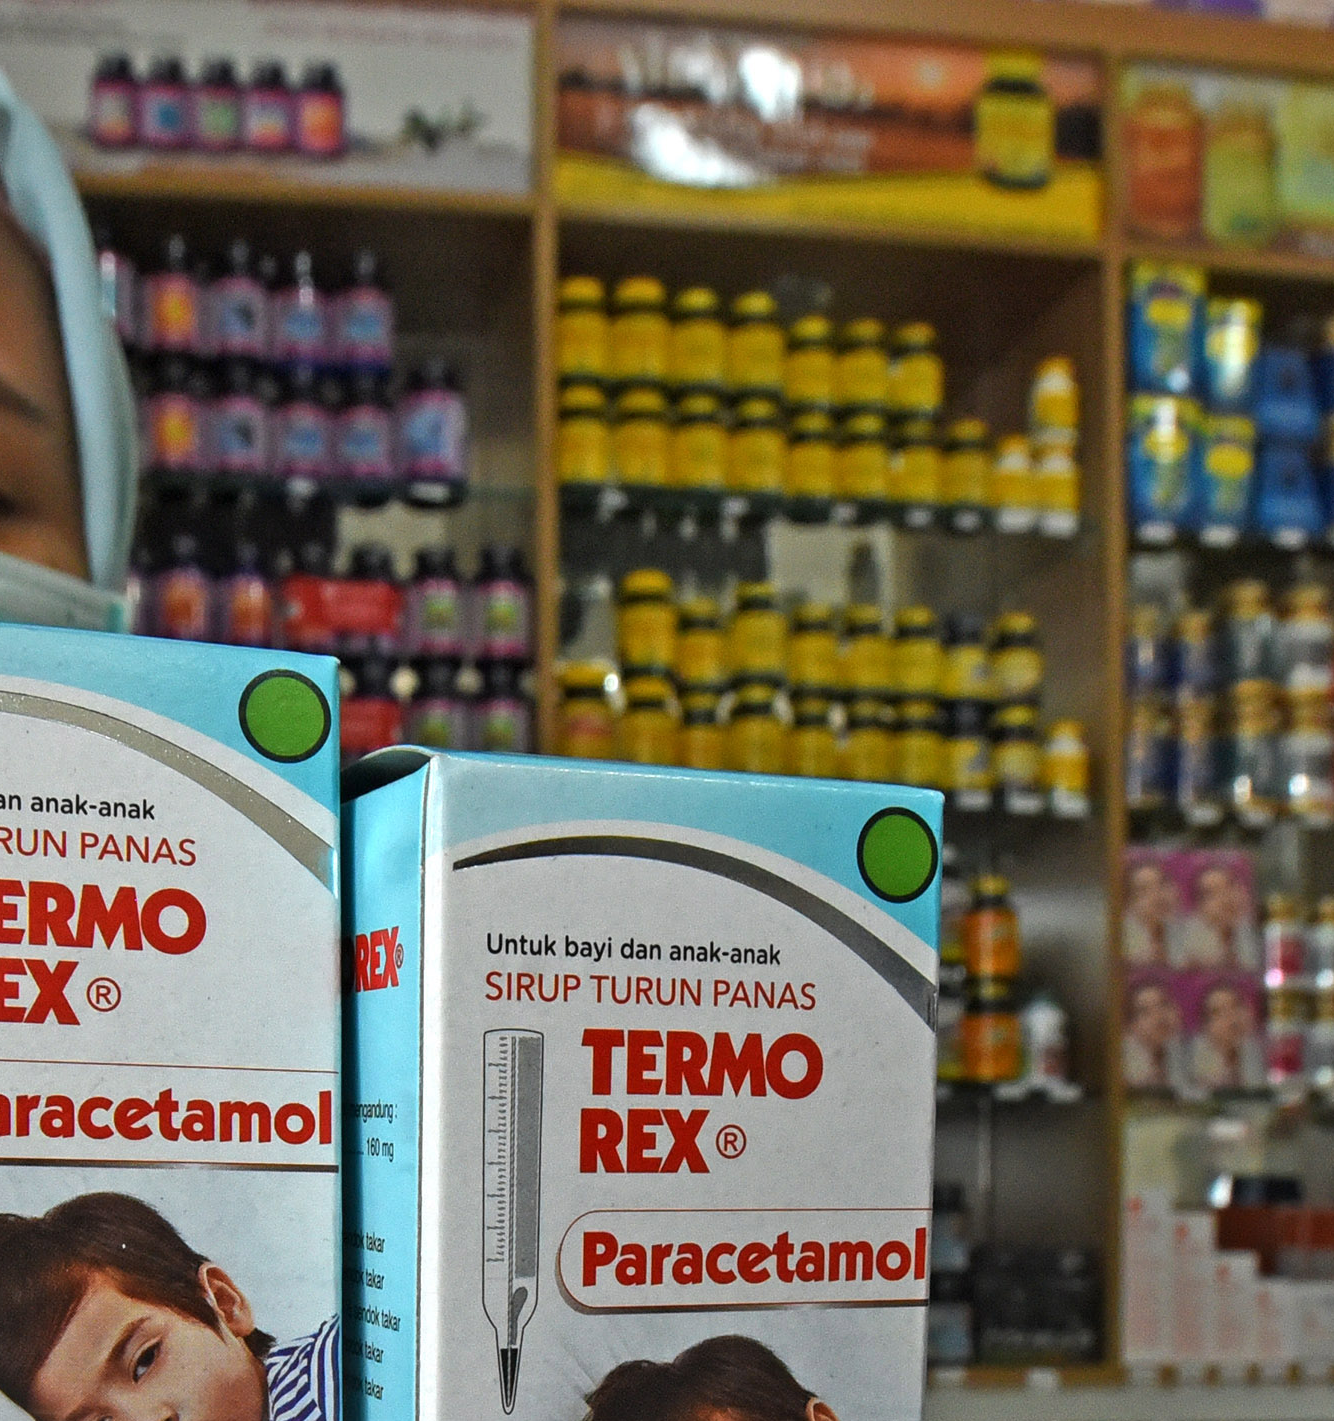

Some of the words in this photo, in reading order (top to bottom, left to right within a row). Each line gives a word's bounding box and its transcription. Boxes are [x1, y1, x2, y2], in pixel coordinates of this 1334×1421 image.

[30, 793, 154, 820] anak-anak
[81, 832, 196, 866] PANAS
[487, 932, 556, 956] Untuk
[565, 935, 612, 962] bayi
[620, 937, 661, 960] dan
[669, 941, 780, 965] anak-anak
[485, 971, 581, 1002] SIRUP
[589, 975, 701, 1006] TURUN
[713, 979, 815, 1010] PANAS
[581, 1028, 823, 1099] TERMO
[582, 1227, 926, 1287] Paracetamol
